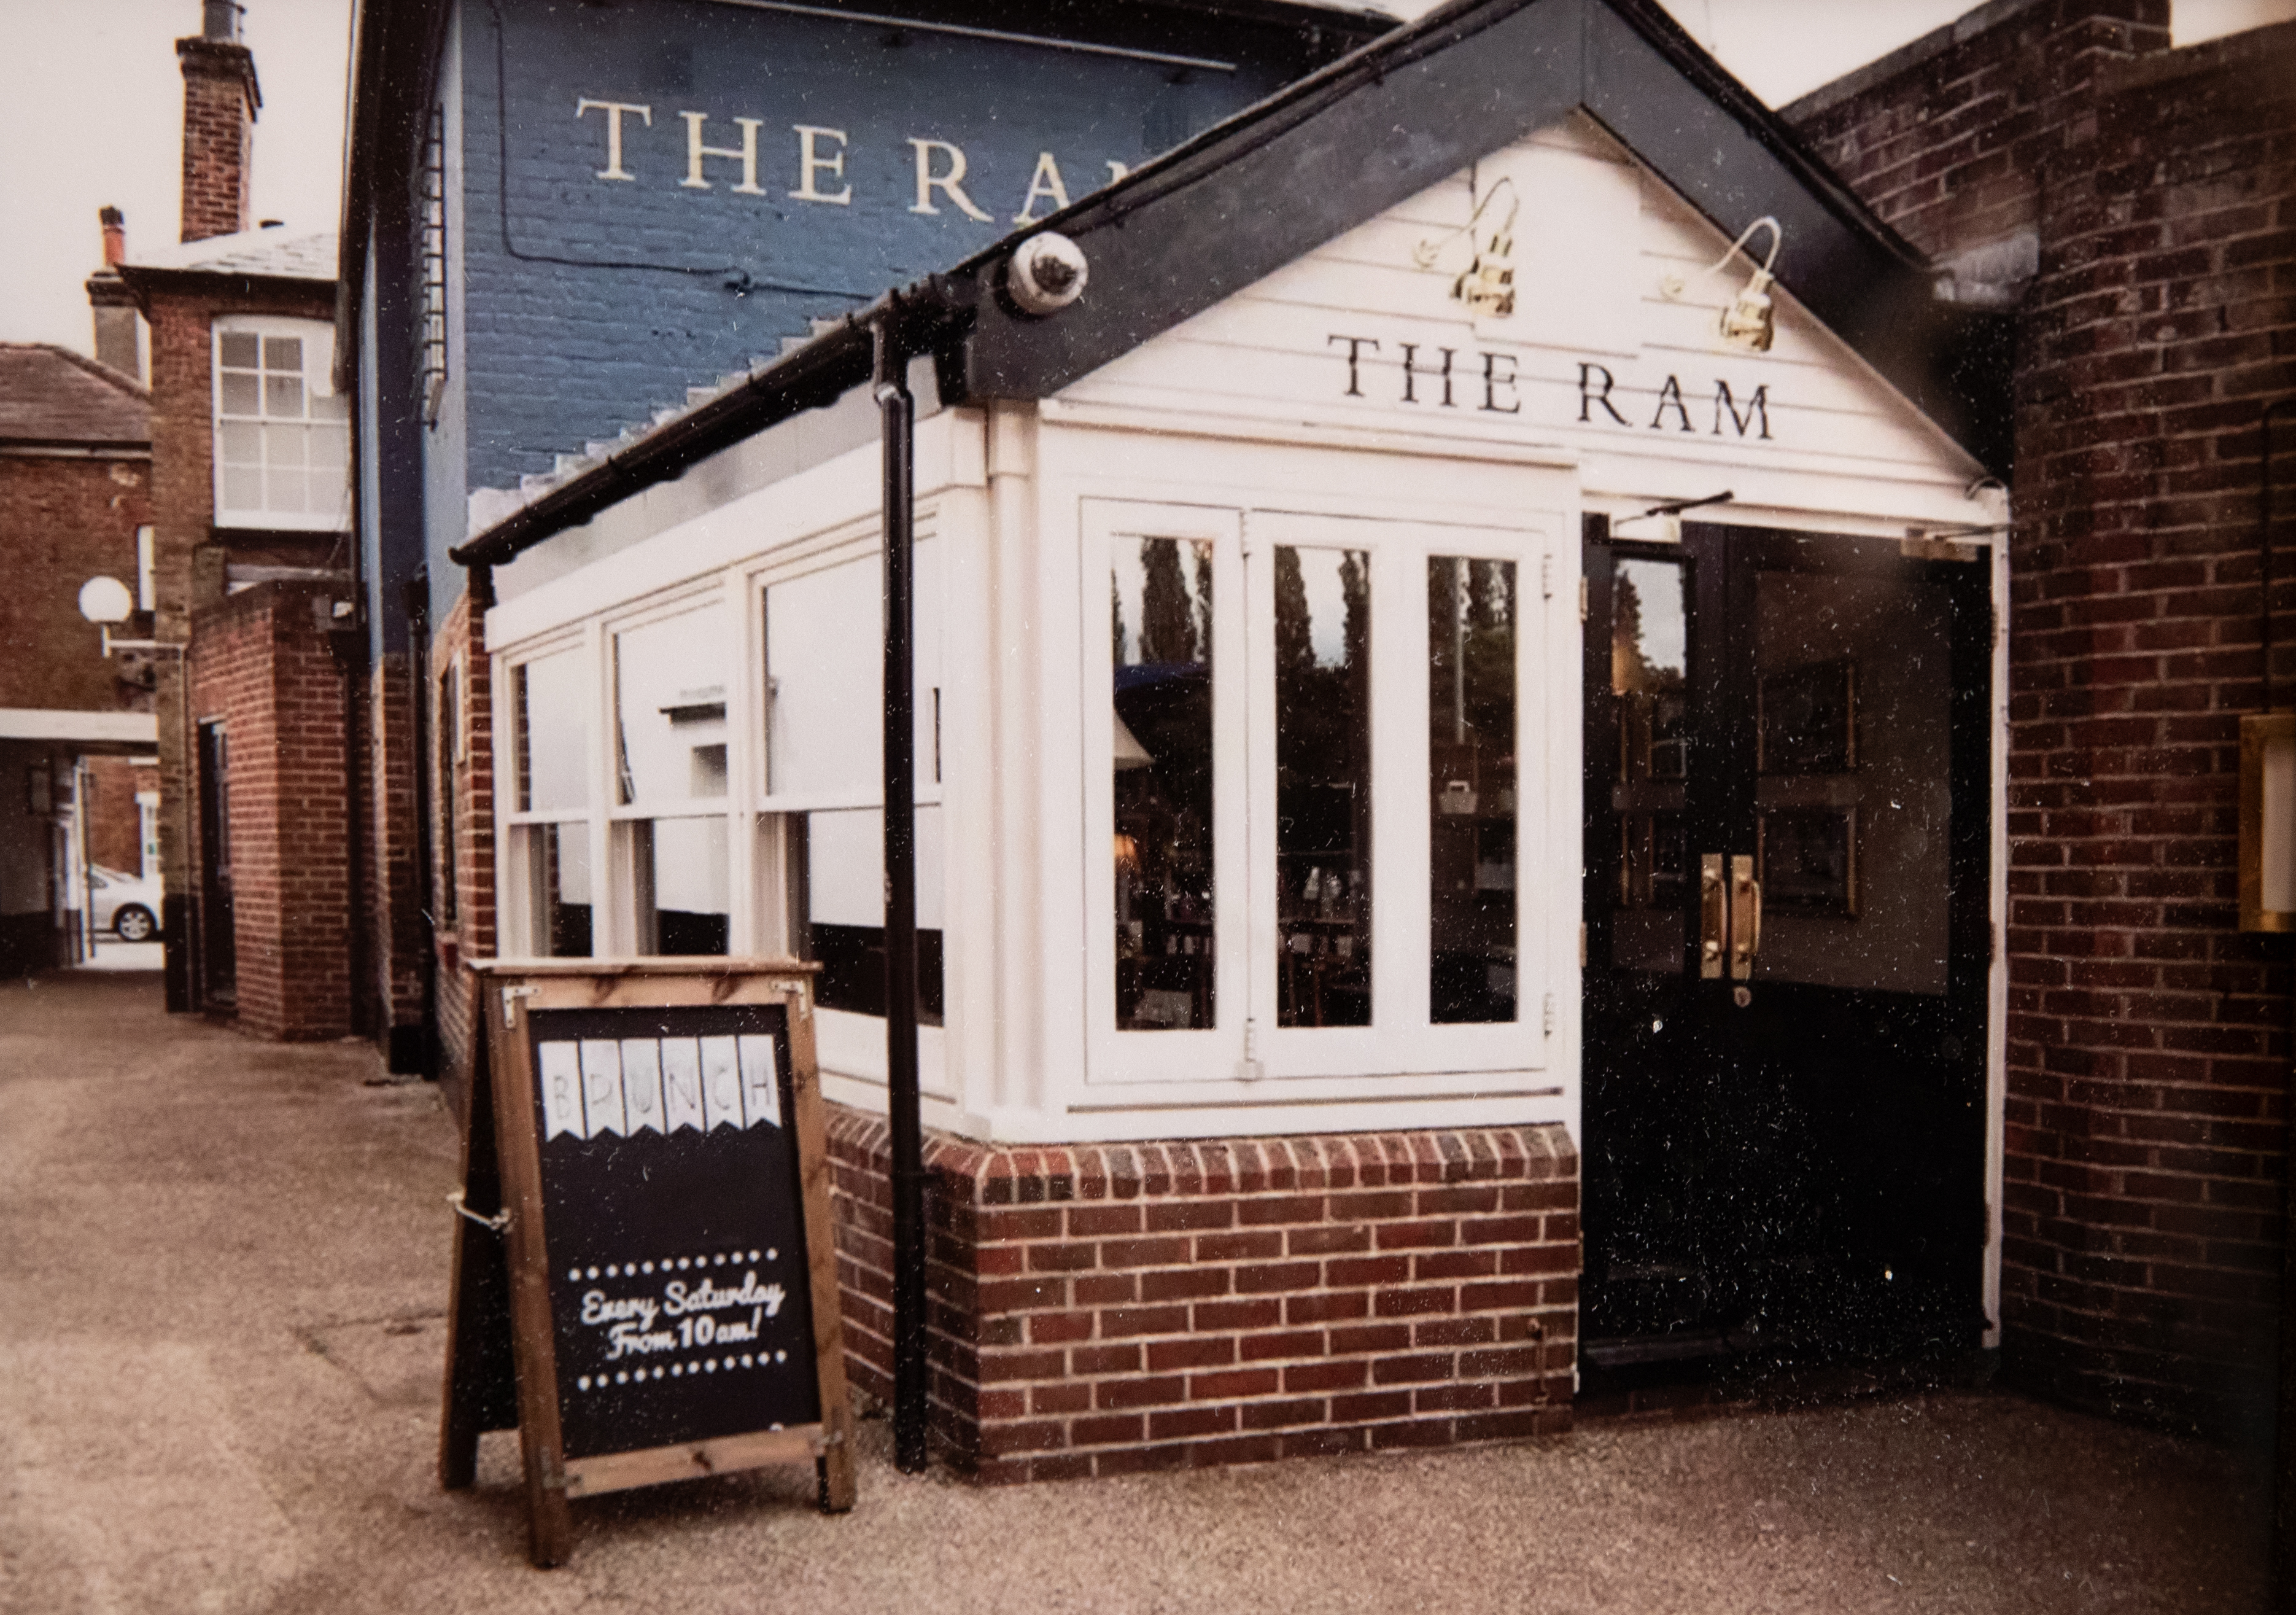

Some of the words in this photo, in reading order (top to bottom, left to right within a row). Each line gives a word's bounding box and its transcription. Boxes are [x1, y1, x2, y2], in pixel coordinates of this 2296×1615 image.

[576, 98, 852, 205] THE
[907, 136, 1128, 225] RA
[1328, 334, 1521, 414] THE
[1577, 362, 1774, 440] RAM
[581, 1289, 659, 1332] Every
[663, 1270, 786, 1317] Saturday
[606, 1321, 677, 1361] From
